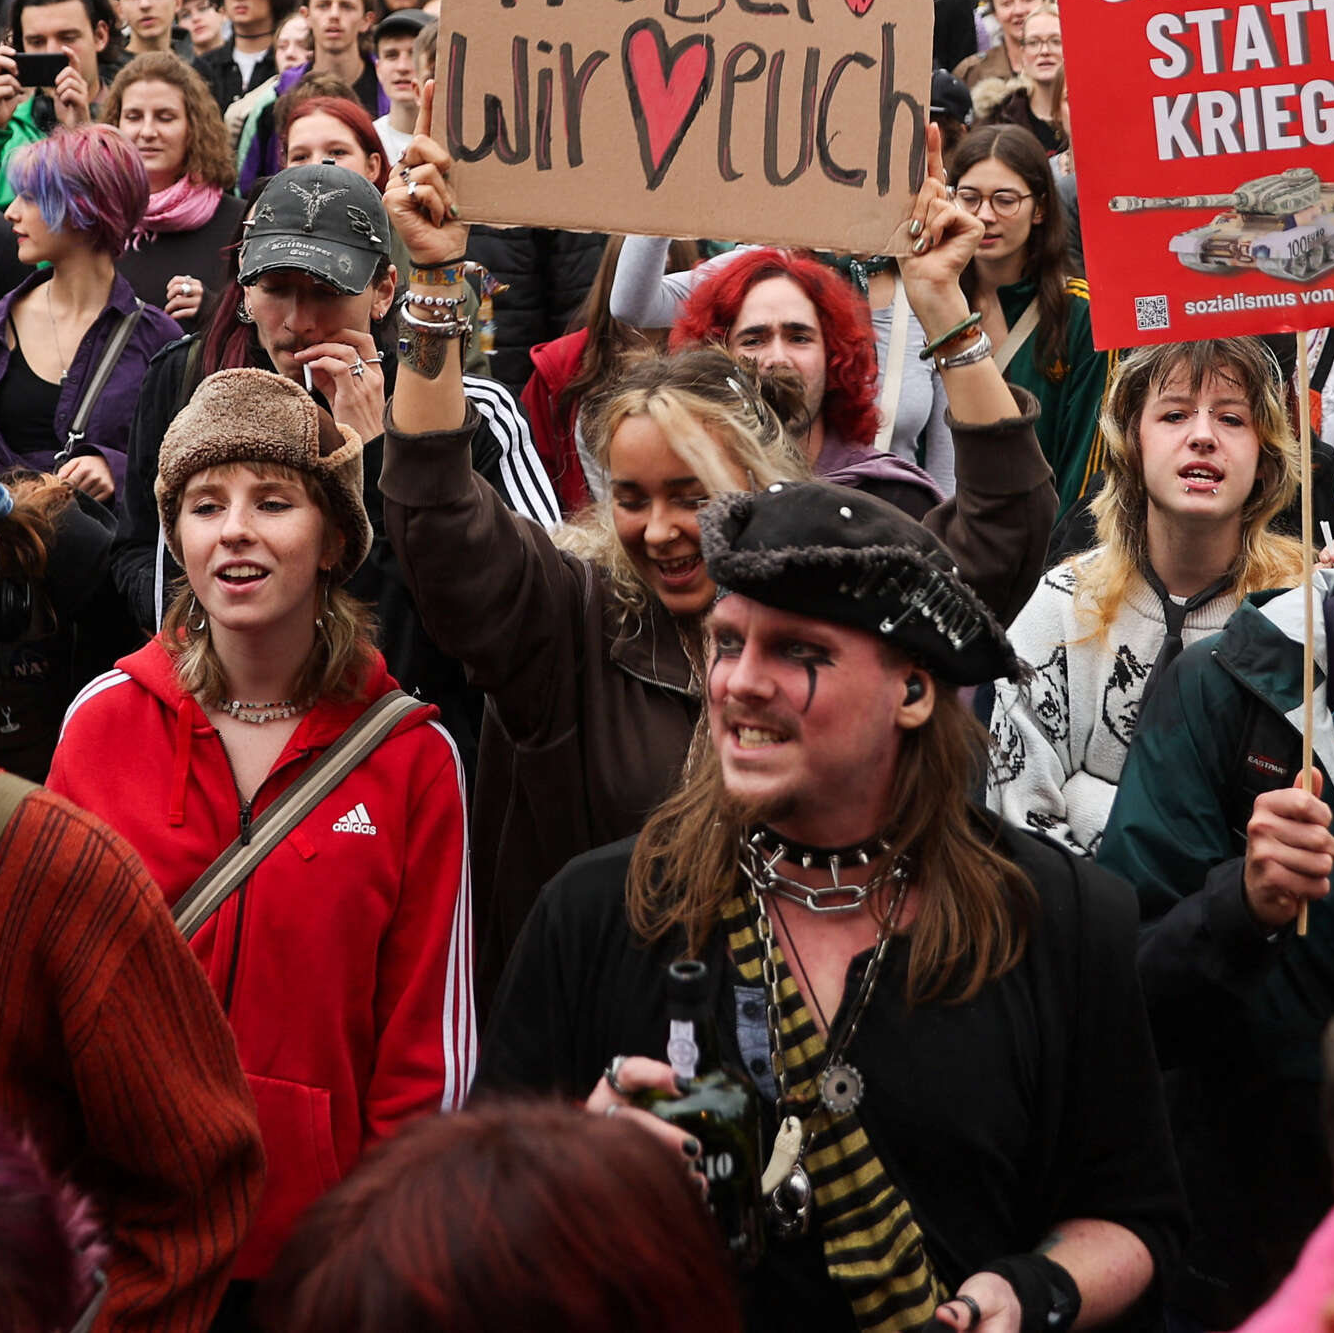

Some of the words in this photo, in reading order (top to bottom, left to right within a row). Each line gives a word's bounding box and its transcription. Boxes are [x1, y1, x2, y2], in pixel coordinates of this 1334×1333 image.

[717, 21, 926, 196] euch
[1184, 291, 1297, 316] sozialismus
[332, 821, 377, 836] adidas
